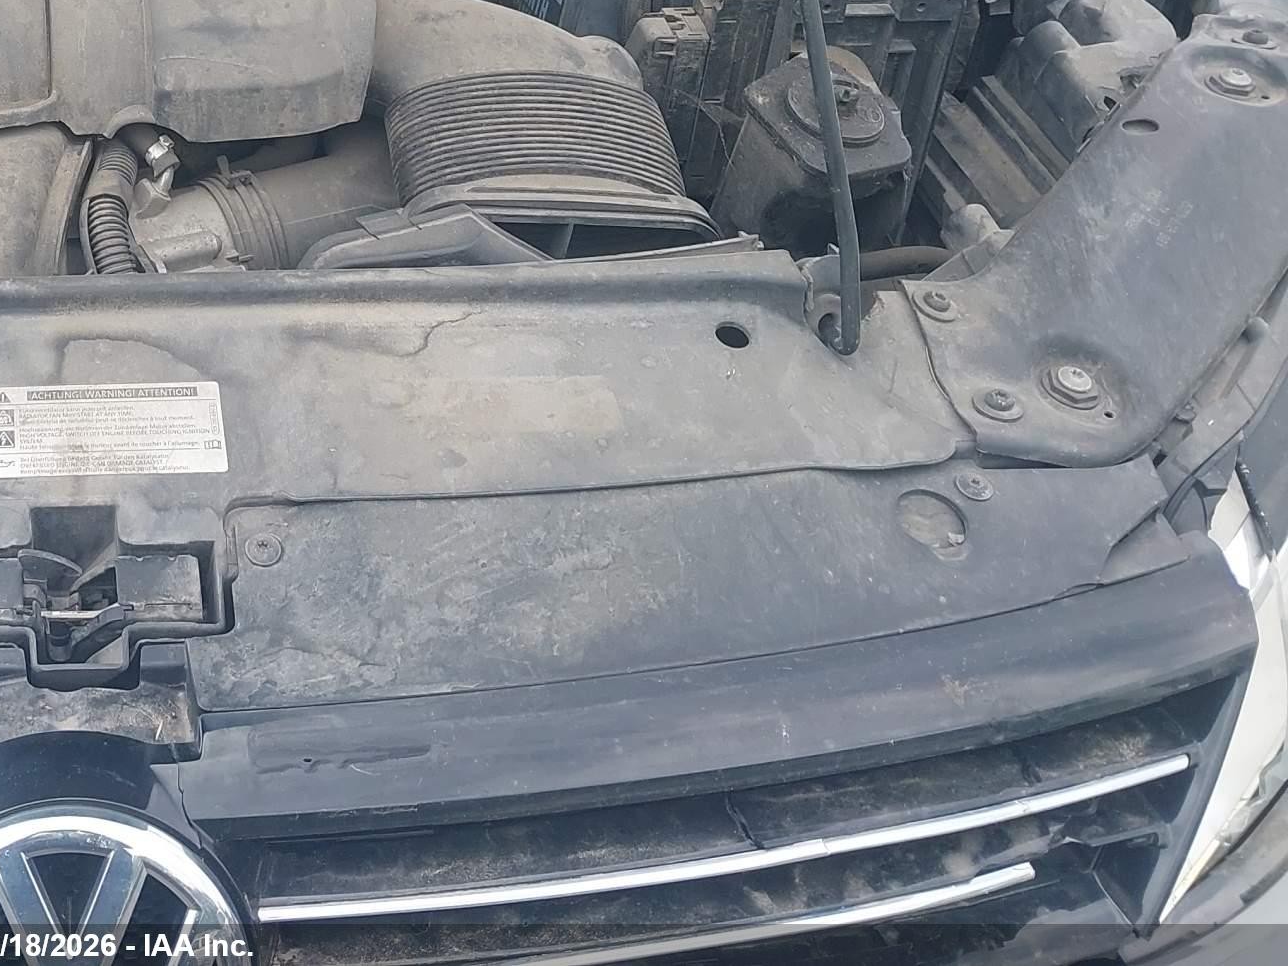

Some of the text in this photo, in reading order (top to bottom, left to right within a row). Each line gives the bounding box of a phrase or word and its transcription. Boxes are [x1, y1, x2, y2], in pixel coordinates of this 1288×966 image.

[31, 387, 196, 400] ACHTUNG! WARNING! ATTENTION!
